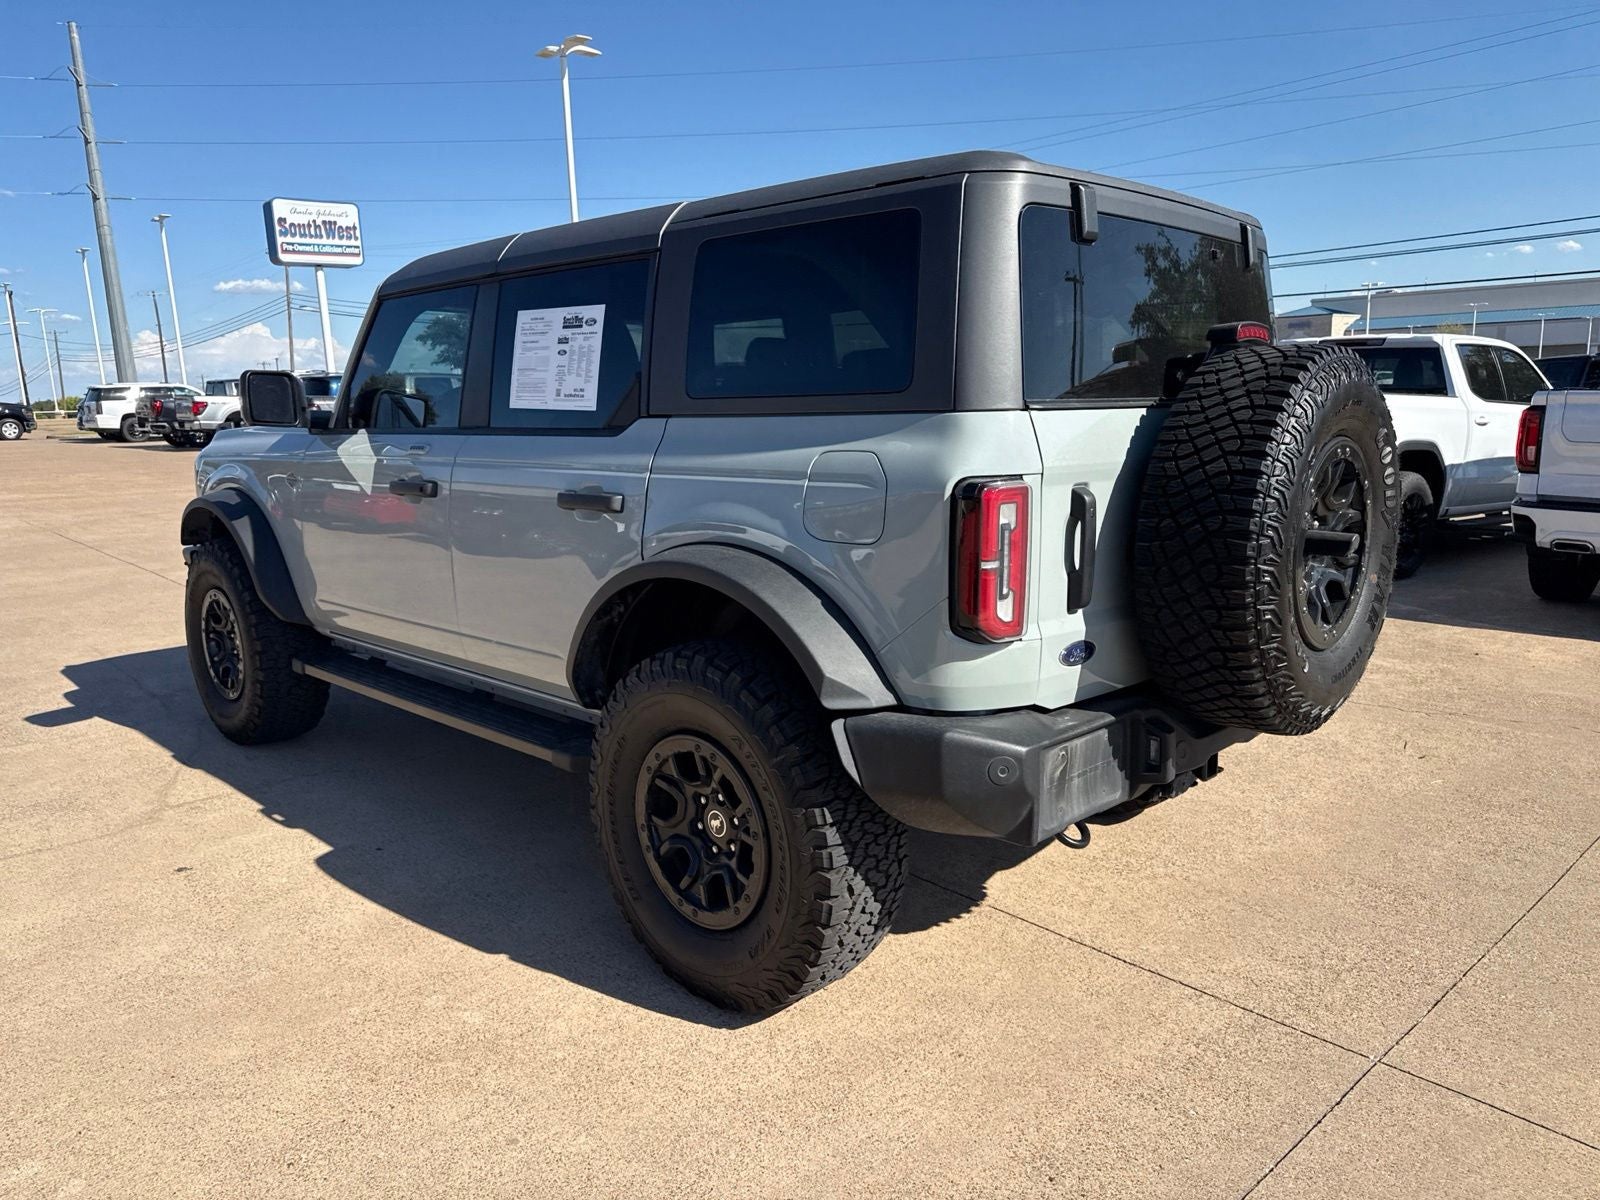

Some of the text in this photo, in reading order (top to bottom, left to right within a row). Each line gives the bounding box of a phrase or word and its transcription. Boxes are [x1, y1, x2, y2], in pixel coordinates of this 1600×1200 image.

[277, 216, 359, 242] SouthWest
[282, 243, 360, 255] Pre-Owned & Collision Center
